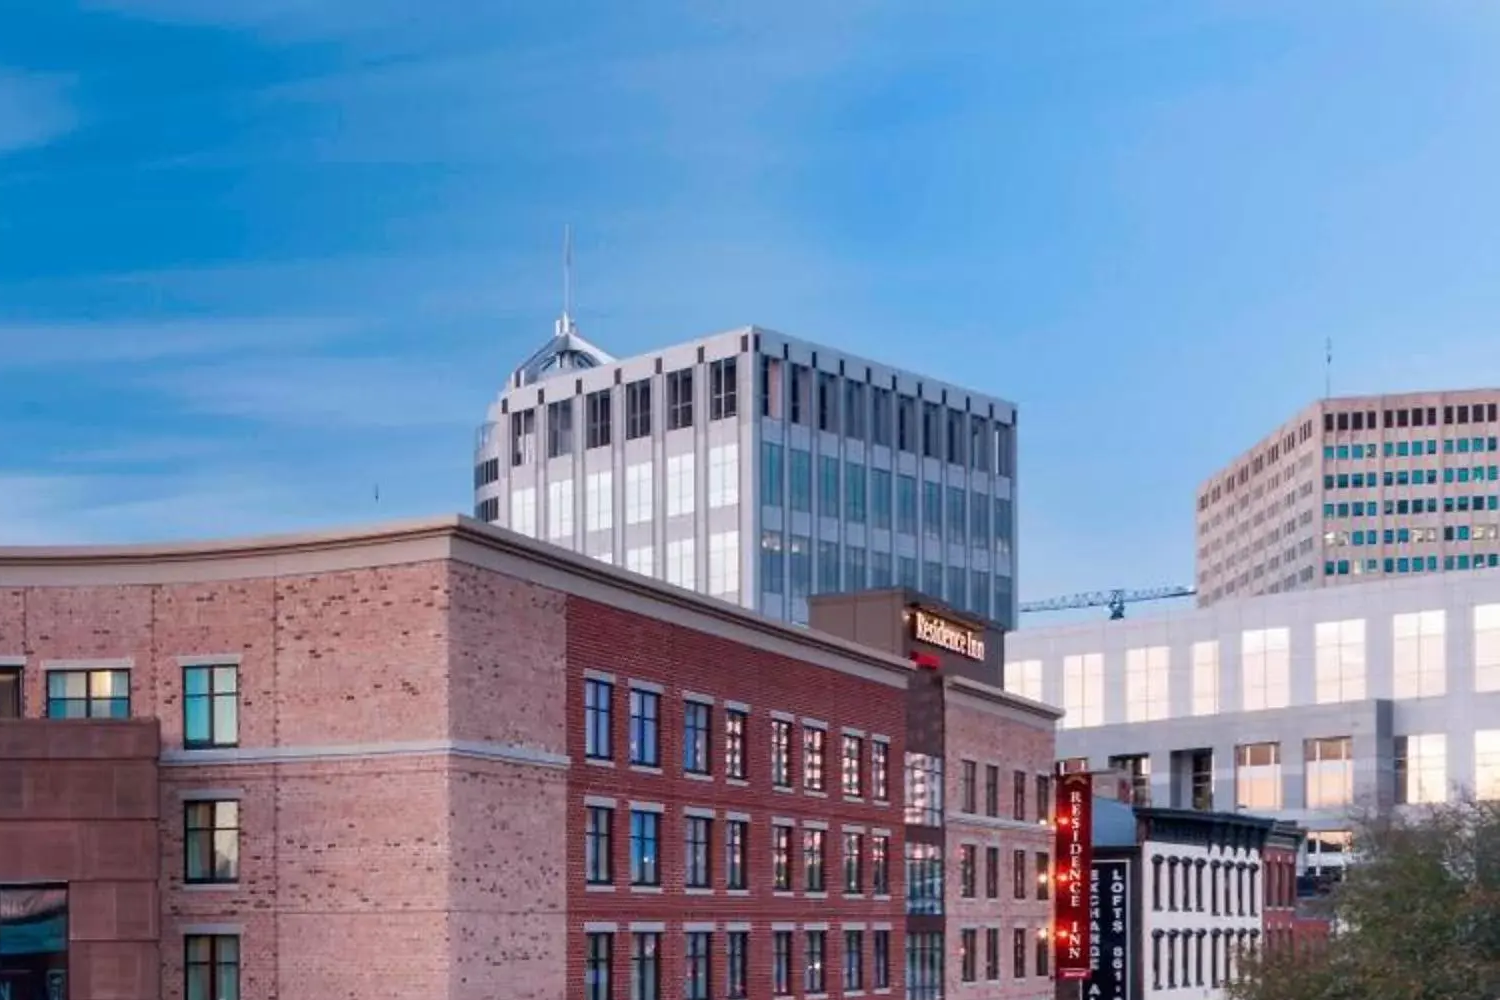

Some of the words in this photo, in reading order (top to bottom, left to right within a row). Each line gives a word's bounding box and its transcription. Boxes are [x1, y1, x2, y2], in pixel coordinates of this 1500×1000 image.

[915, 611, 967, 655] Residence
[967, 631, 985, 661] Inn
[1069, 791, 1082, 907] RESIDENCE
[1110, 869, 1124, 933] LOFTS
[1069, 921, 1080, 959] INN
